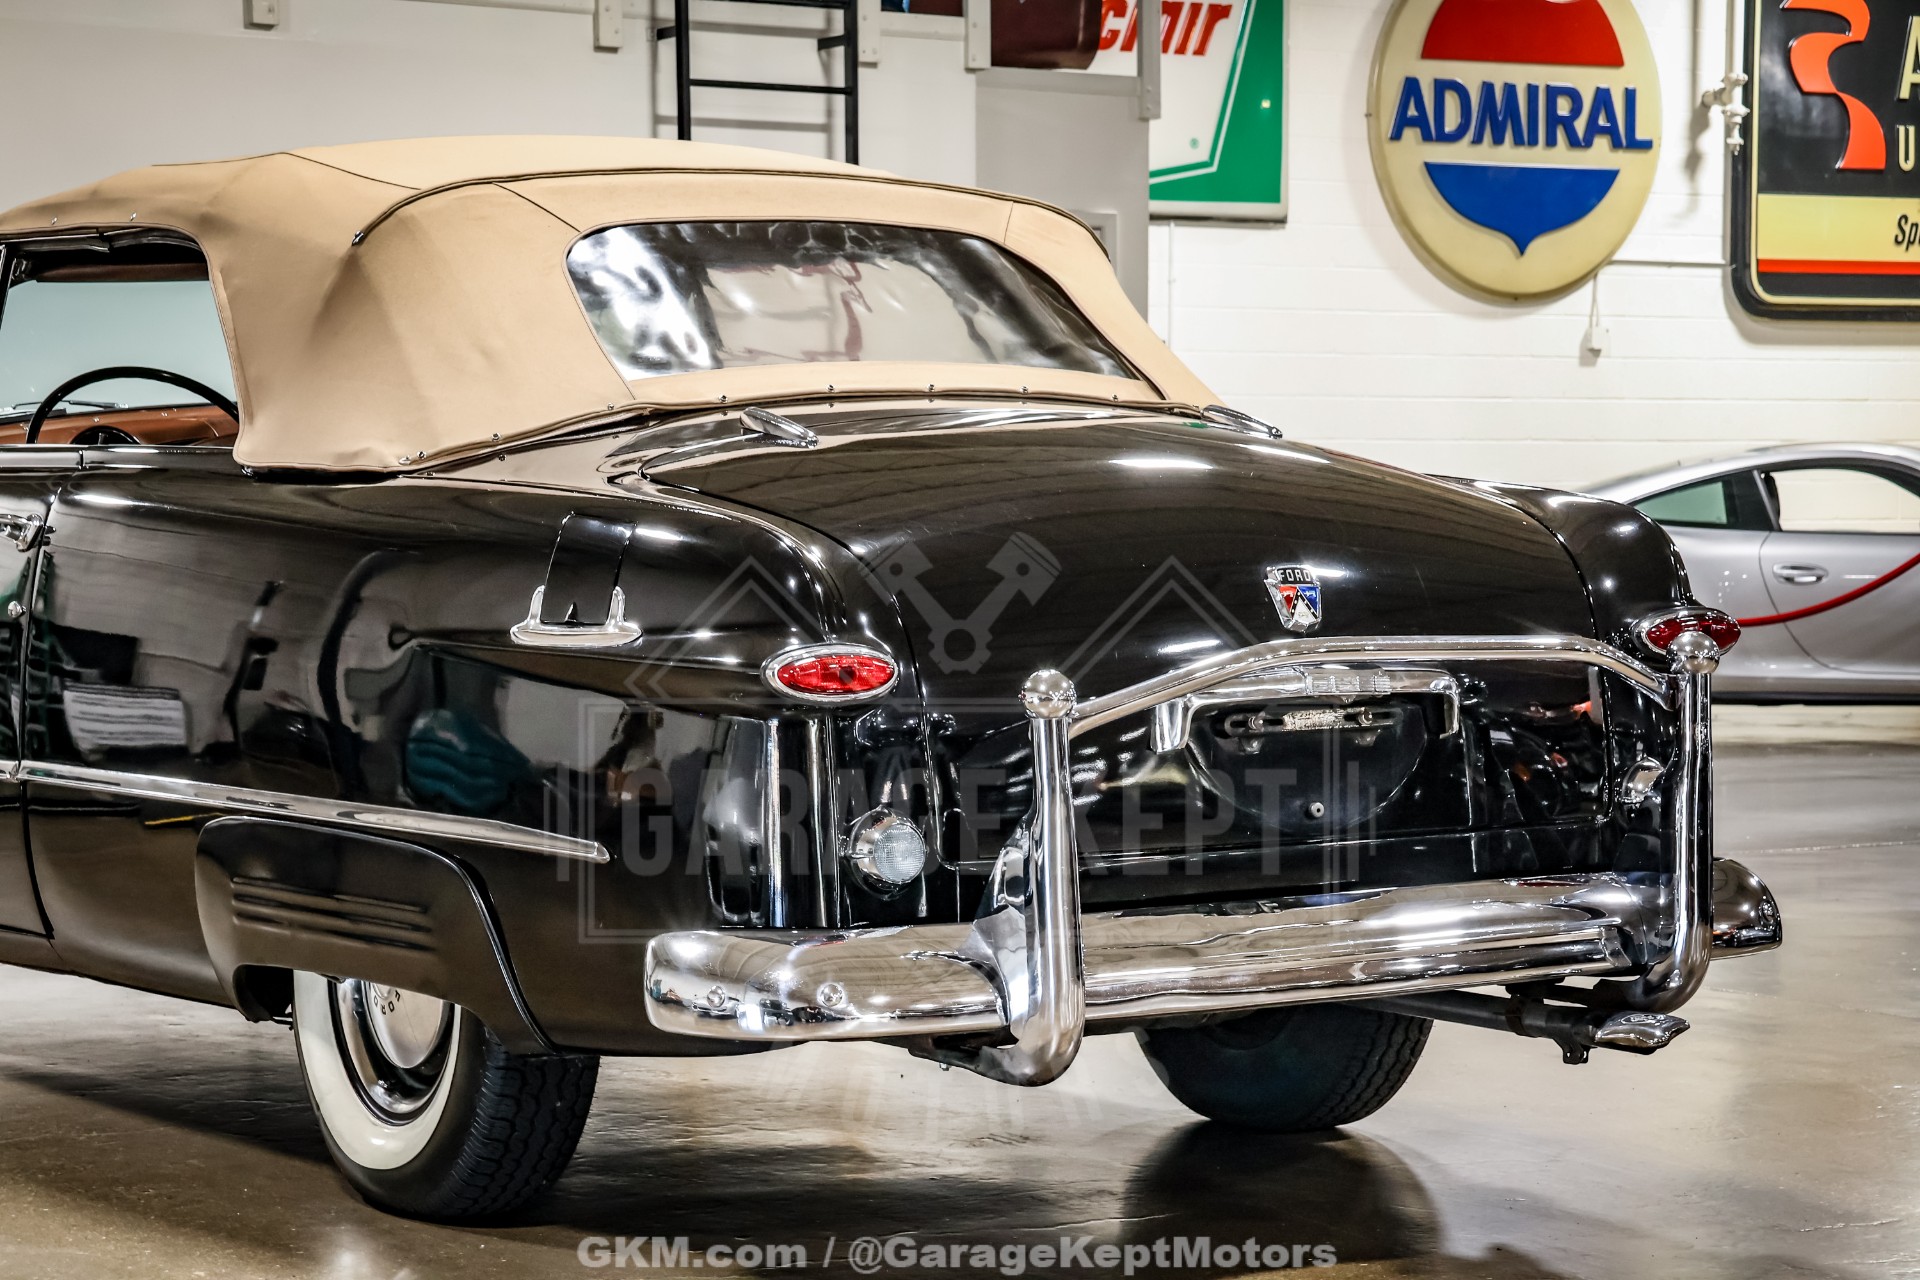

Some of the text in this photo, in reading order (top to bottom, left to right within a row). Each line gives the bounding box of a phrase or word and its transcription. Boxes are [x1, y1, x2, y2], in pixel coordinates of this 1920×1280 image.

[1389, 76, 1653, 150] ADMIRAL
[1894, 214, 1920, 252] Sp
[1278, 569, 1311, 582] FORD
[374, 990, 400, 1015] FORD
